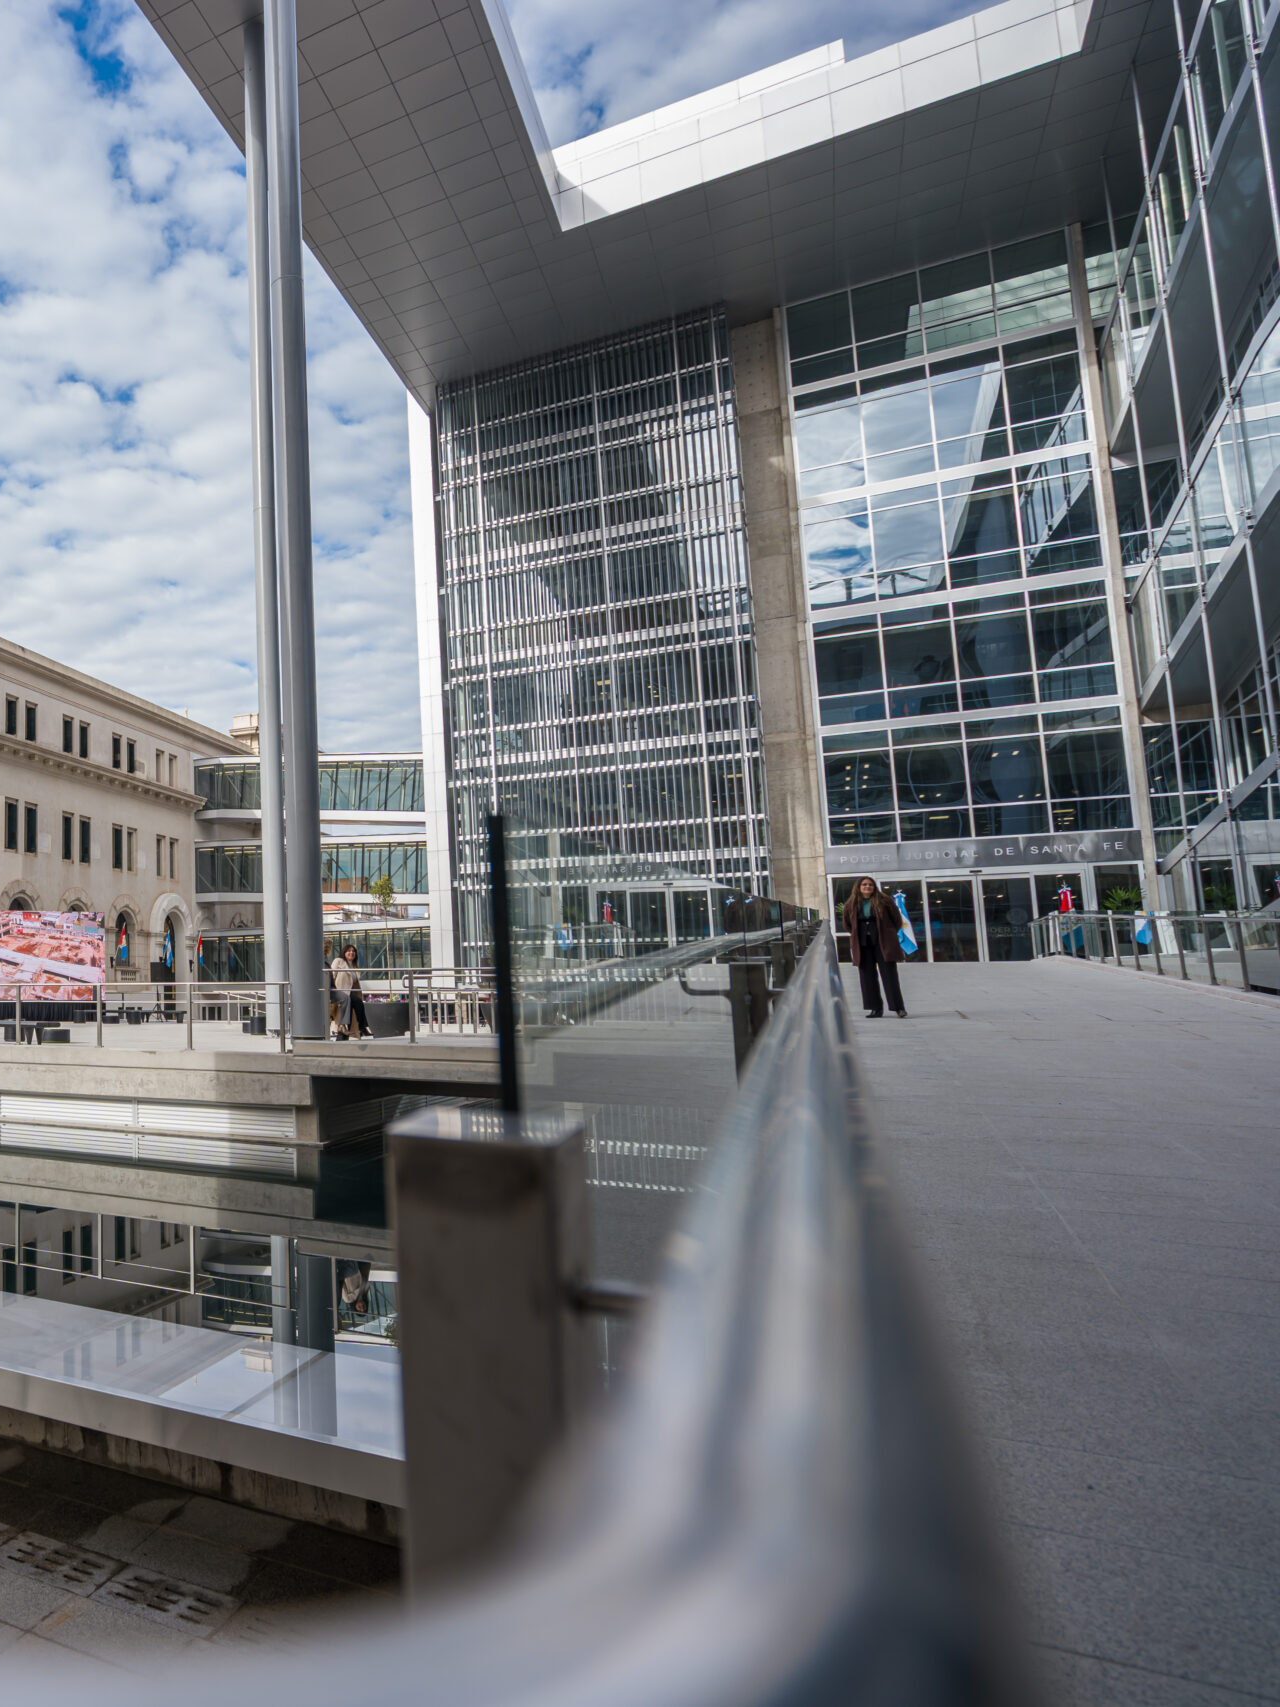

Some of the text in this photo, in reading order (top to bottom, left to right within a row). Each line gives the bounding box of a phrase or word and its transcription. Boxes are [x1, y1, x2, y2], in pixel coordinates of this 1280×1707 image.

[840, 841, 1124, 864] PODER JUDICIAL DE SANTA FE
